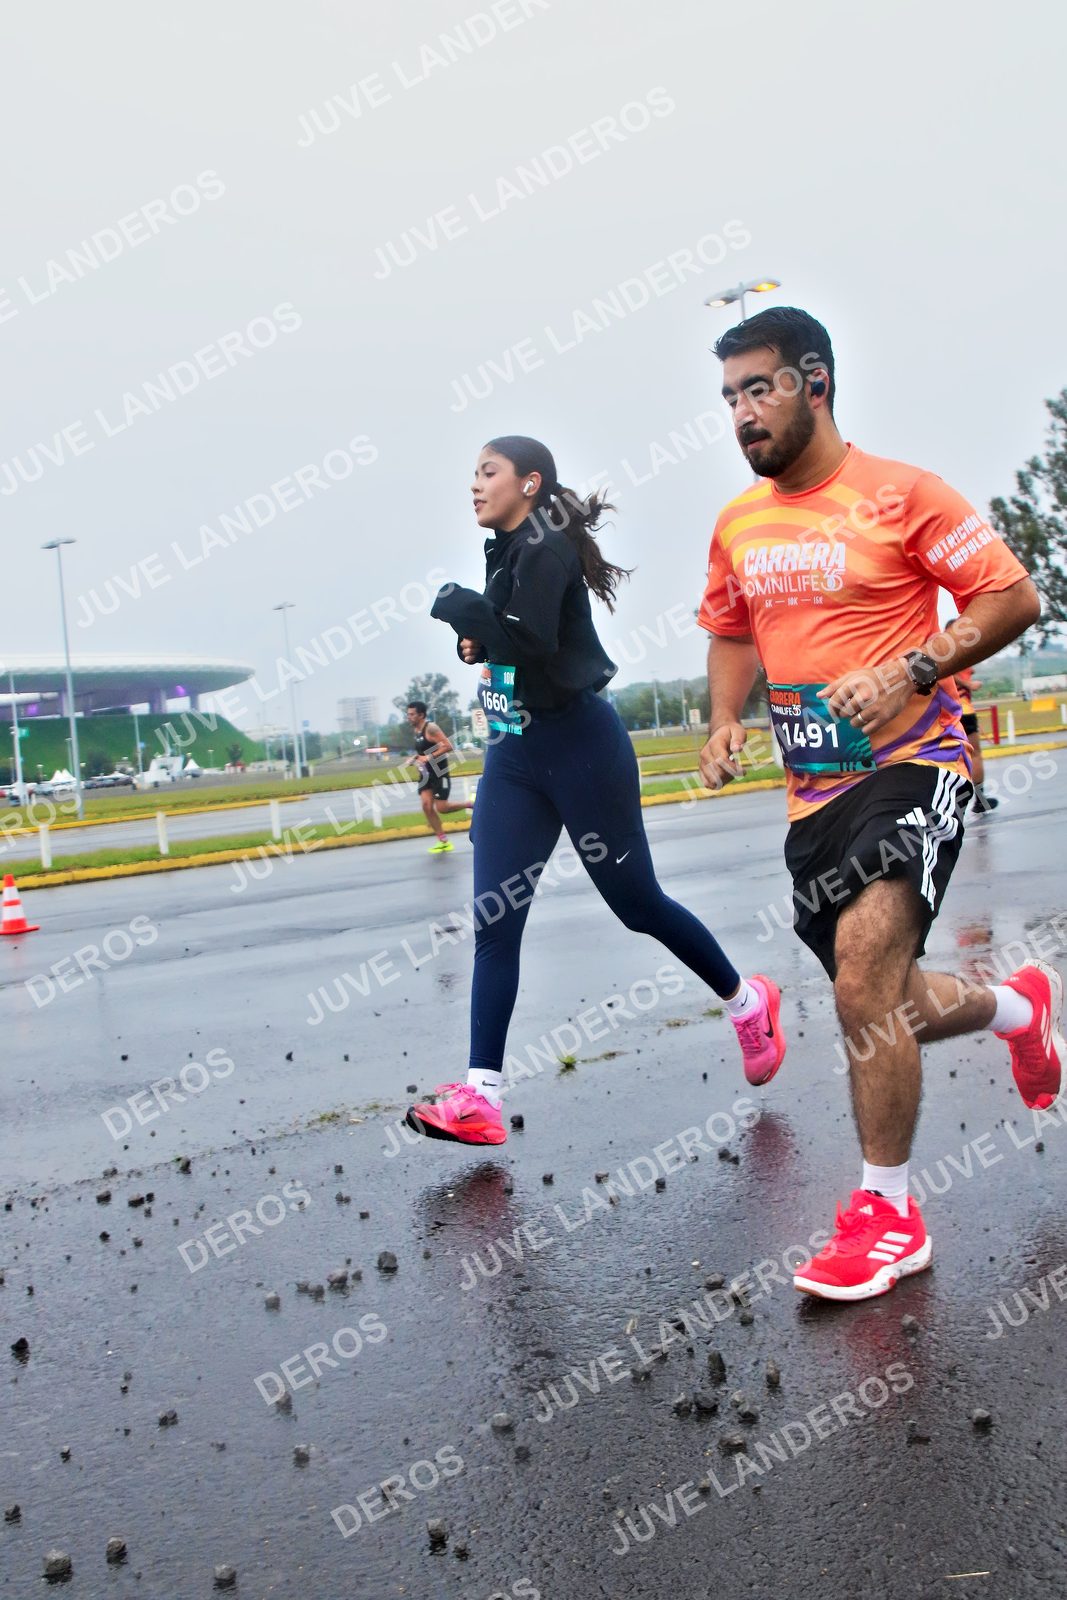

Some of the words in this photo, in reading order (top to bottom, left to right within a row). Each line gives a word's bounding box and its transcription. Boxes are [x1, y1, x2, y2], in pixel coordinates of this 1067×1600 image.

[744, 543, 846, 577] CARRERA
[503, 671, 515, 685] 10K
[481, 690, 508, 713] 1660
[770, 690, 801, 706] ARRERA
[781, 722, 839, 748] 1491
